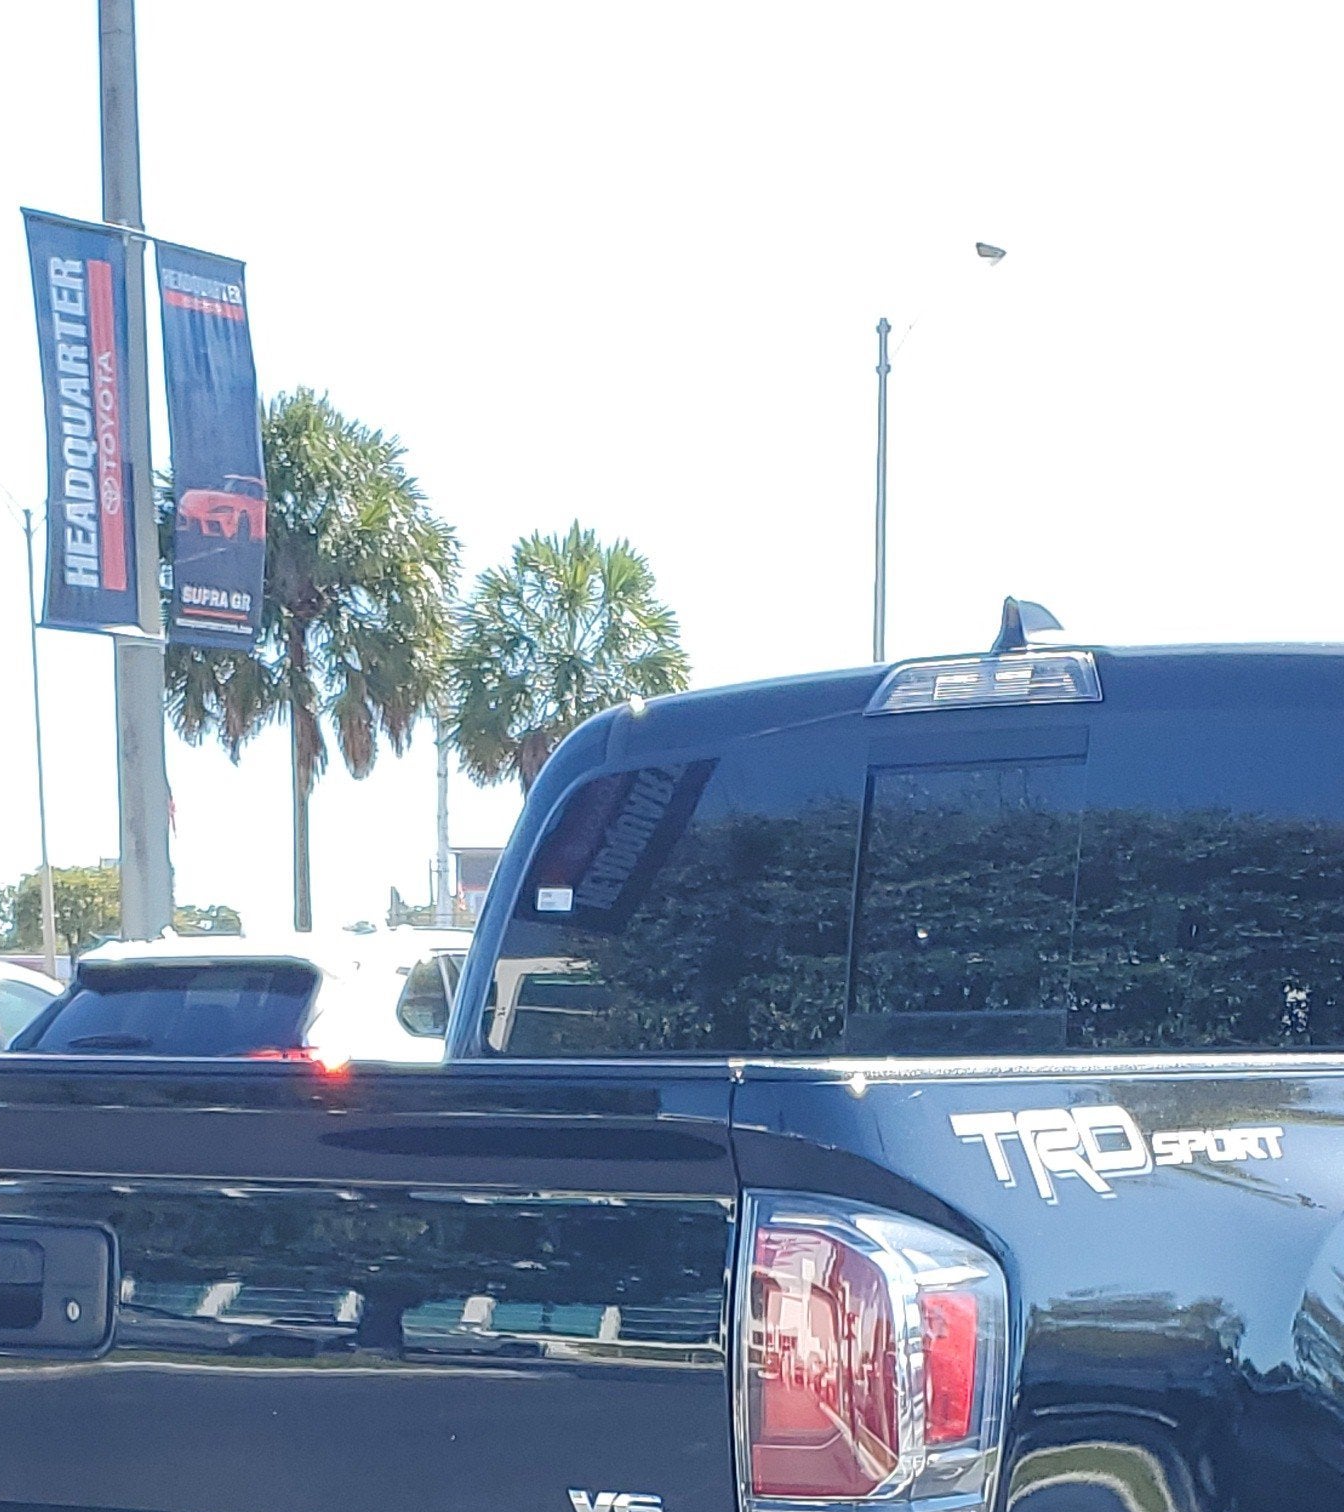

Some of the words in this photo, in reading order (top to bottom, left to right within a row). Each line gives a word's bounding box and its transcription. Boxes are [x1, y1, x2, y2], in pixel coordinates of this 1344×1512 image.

[48, 256, 100, 589] HEADQUARTER
[97, 351, 119, 475] TOYOTA
[182, 585, 229, 609] SUPRA
[231, 591, 251, 612] GR
[949, 1104, 1153, 1206] TRD
[1152, 1126, 1284, 1166] SPORT
